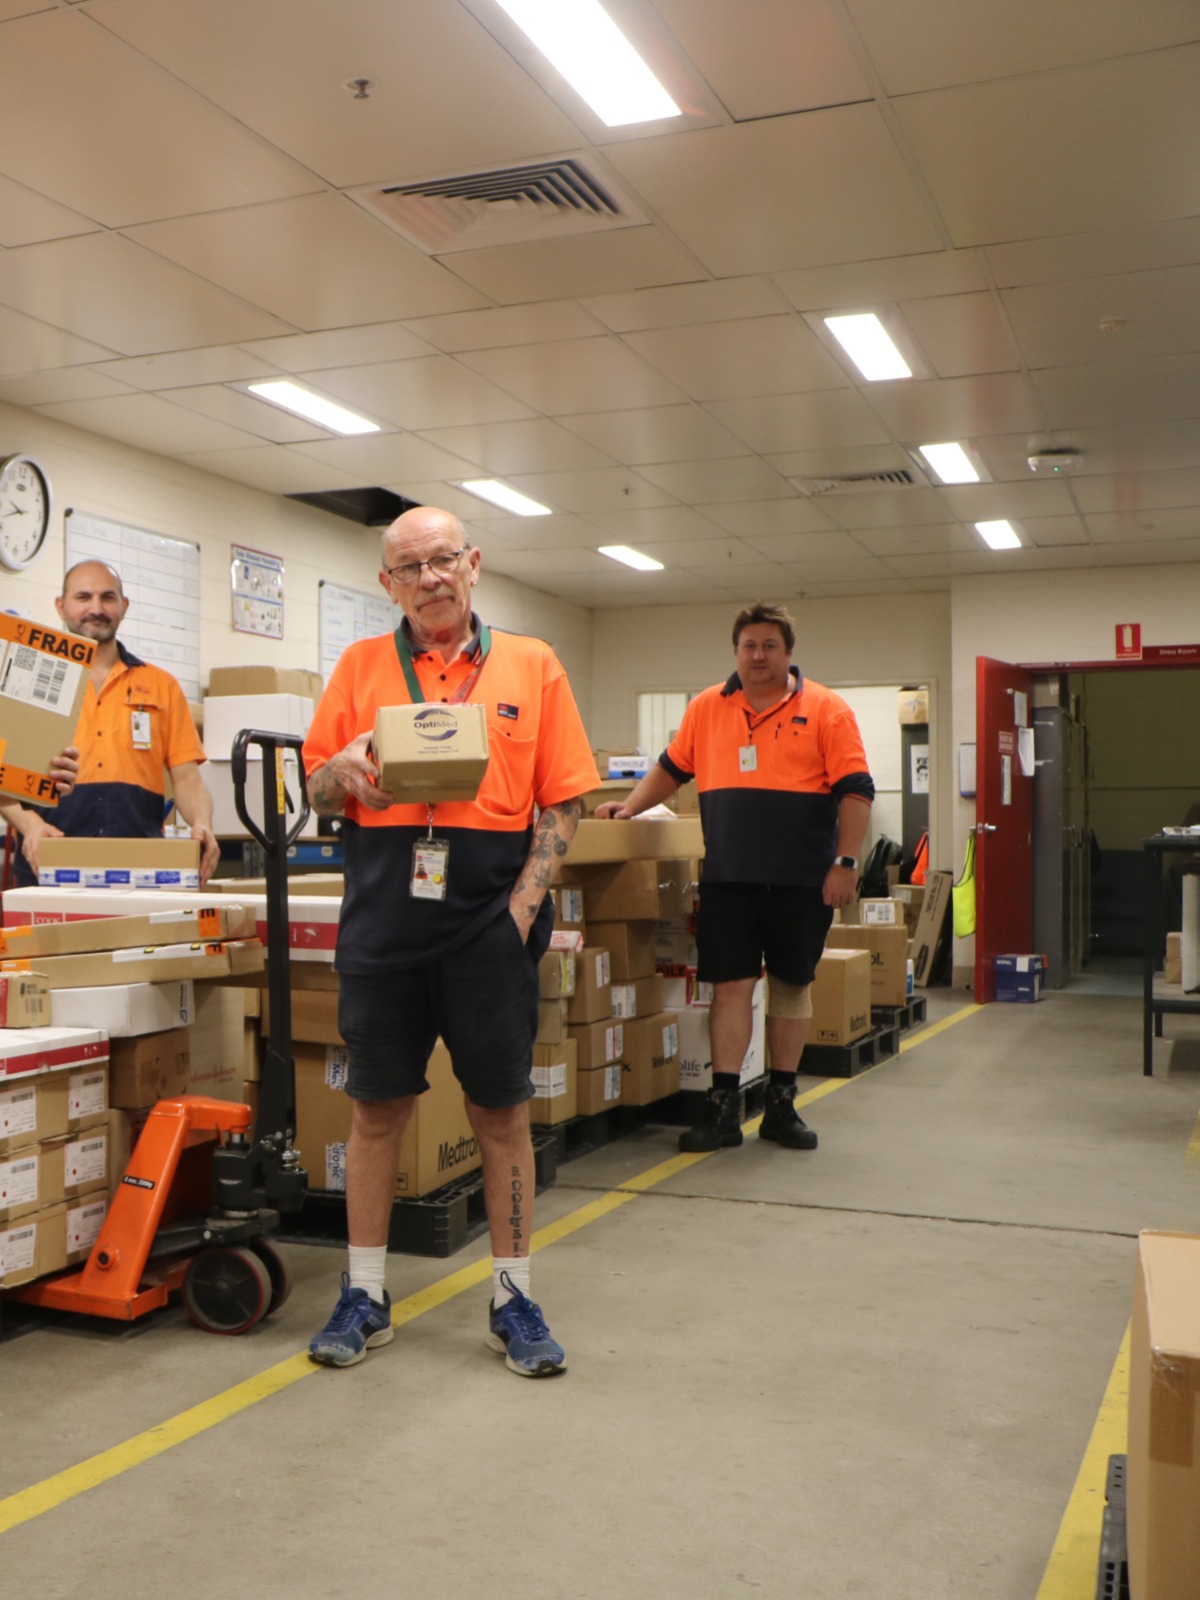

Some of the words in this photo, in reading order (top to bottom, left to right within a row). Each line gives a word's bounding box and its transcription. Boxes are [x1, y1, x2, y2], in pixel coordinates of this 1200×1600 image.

[28, 628, 94, 664] FRAGI
[414, 721, 458, 729] OptiMed
[438, 1134, 480, 1173] Medtron
